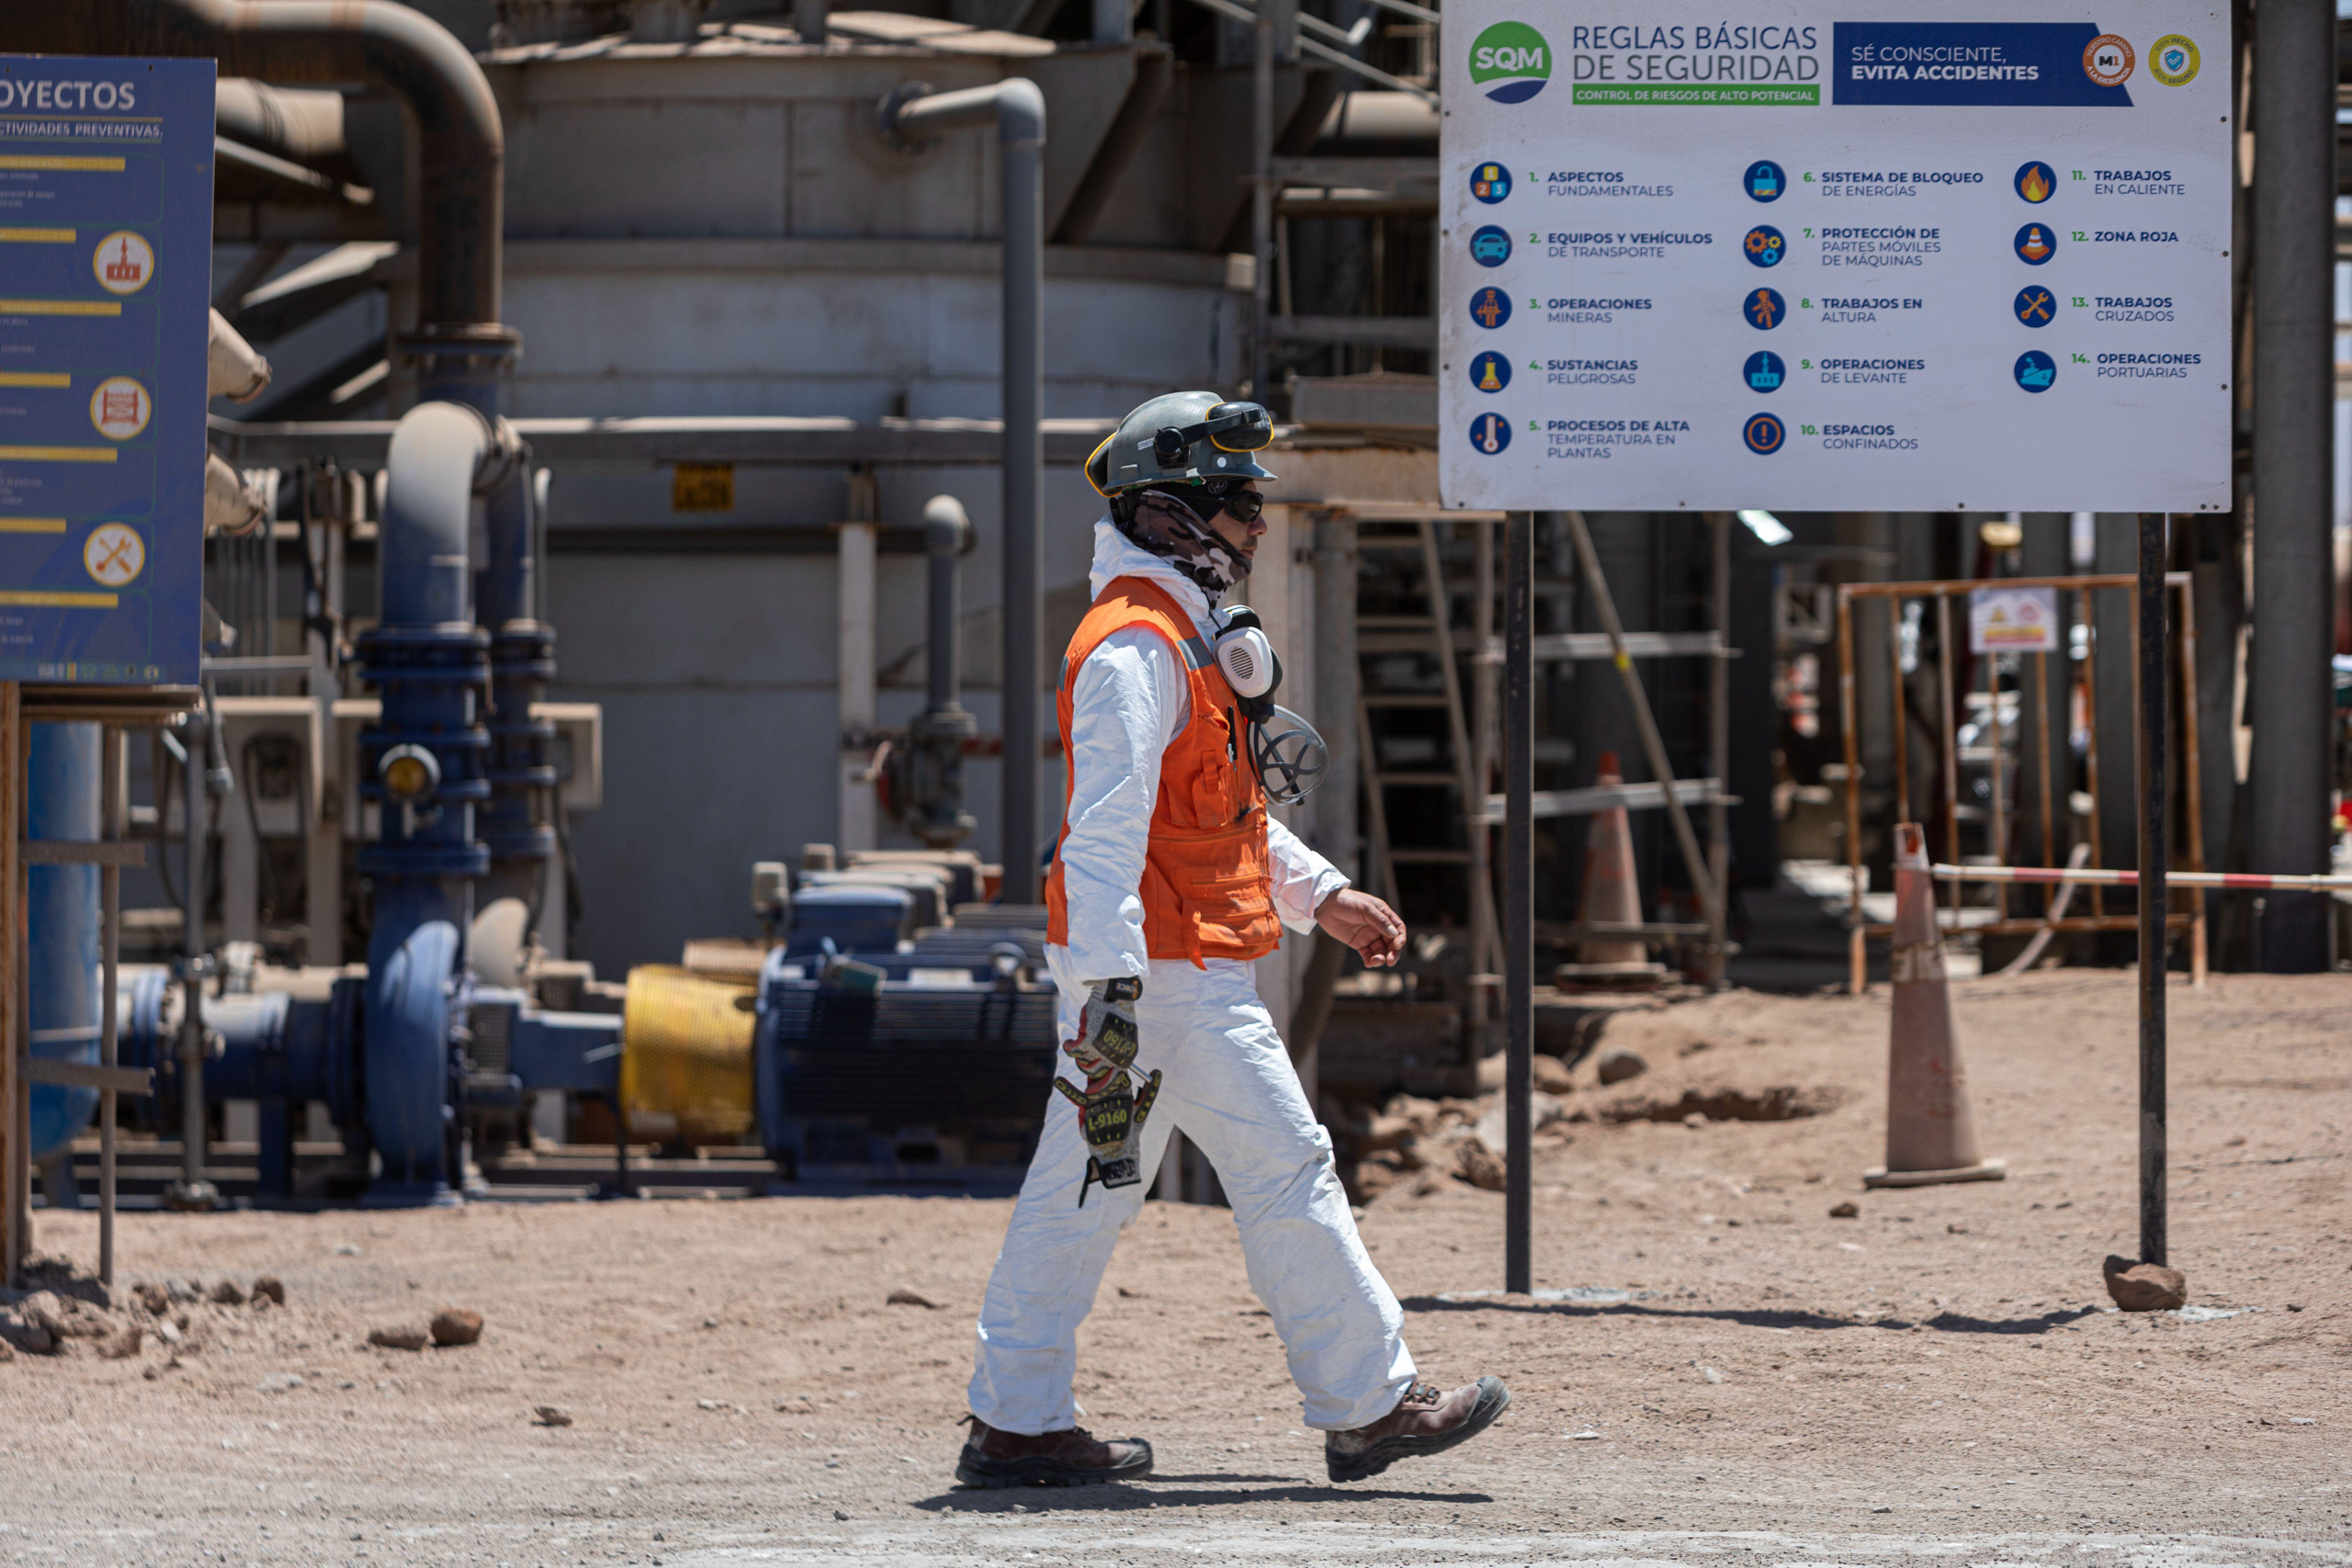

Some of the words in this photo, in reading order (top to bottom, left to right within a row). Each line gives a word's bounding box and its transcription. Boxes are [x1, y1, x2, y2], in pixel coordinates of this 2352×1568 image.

[1573, 26, 1685, 50] REGLAS
[1696, 21, 1817, 50] BÁSICAS
[2086, 37, 2110, 56] NUESTRO
[2111, 37, 2132, 58] CAMINO
[2171, 38, 2194, 52] HECHO
[1476, 46, 1543, 72] SQM
[1851, 44, 1874, 62] SÉ
[1880, 47, 2007, 64] CONSCIENTE,
[2098, 55, 2120, 66] M1
[1574, 54, 1615, 80] DE
[1627, 54, 1819, 81] SEGURIDAD
[1851, 65, 1908, 80] EVITA
[1914, 65, 2039, 81] ACCIDENTES
[2168, 70, 2194, 84] SEGURO
[1576, 90, 1632, 101] CONTROL
[1634, 91, 1650, 101] DE
[1653, 91, 1700, 101] RIESGOS
[1702, 91, 1718, 101] DE
[1720, 91, 1748, 101] ALTO
[1751, 91, 1815, 101] POTENCIAL
[1529, 172, 1538, 182] 1.
[1548, 172, 1624, 182] ASPECTOS
[1804, 172, 1815, 182] 6.
[1822, 173, 1883, 182] SISTEMA
[1889, 173, 1908, 182] DE
[1913, 173, 1984, 185] BLOQUEO
[2072, 171, 2086, 180] 11.
[2094, 171, 2171, 181] TRABAJOS
[1548, 186, 1673, 196] FUNDAMENTALES
[1823, 186, 1841, 196] DE
[1847, 184, 1917, 196] ENERGÍAS
[2095, 185, 2113, 194] EN
[2118, 184, 2185, 195] CALIENTE
[1804, 229, 1815, 238] 7.
[1822, 225, 1916, 238] PROTECCIÓN
[1920, 229, 1939, 238] DE
[2072, 231, 2088, 242] 12.
[2095, 231, 2136, 242] ZONA
[2141, 232, 2178, 242] ROJA
[1529, 233, 1541, 243] 2.
[1548, 233, 1612, 245] EQUIPOS
[1617, 233, 1626, 243] Y
[1631, 231, 1713, 243] VEHÍCULOS
[1823, 242, 1875, 252] PARTES
[1880, 239, 1941, 252] MÓVILES
[1548, 247, 1567, 257] DE
[1572, 247, 1665, 257] TRANSPORTE
[1823, 255, 1841, 265] DE
[1847, 253, 1923, 267] MÁQUINAS
[1529, 299, 1541, 309] 3.
[1548, 299, 1652, 310] OPERACIONES
[1801, 299, 1814, 309] 8.
[1822, 299, 1899, 309] TRABAJOS
[1904, 299, 1922, 309] EN
[2072, 298, 2088, 307] 13.
[2095, 298, 2173, 307] TRABAJOS
[1548, 312, 1612, 322] MINERAS
[1822, 312, 1876, 321] ALTURA
[2096, 311, 2174, 321] CRUZADOS
[1801, 359, 1814, 369] 9.
[1821, 359, 1925, 370] OPERACIONES
[2072, 354, 2090, 364] 14.
[2098, 354, 2201, 364] OPERACIONES
[1529, 360, 1543, 370] 4.
[1548, 360, 1638, 370] SUSTANCIAS
[1821, 373, 1840, 383] DE
[1846, 373, 1906, 383] LEVANTE
[2098, 367, 2187, 378] PORTUARIAS
[1548, 374, 1635, 384] PELIGROSAS
[1529, 421, 1541, 431] 5.
[1548, 421, 1625, 431] PROCESOS
[1631, 421, 1649, 431] DE
[1654, 421, 1690, 431] ALTA
[1801, 425, 1818, 434] 10.
[1824, 425, 1894, 435] ESPACIOS
[1548, 434, 1652, 445] TEMPERATURA
[1657, 434, 1675, 445] EN
[1824, 438, 1918, 449] CONFINADOS
[1548, 447, 1611, 457] PLANTAS
[1088, 1110, 1127, 1132] L-9160
